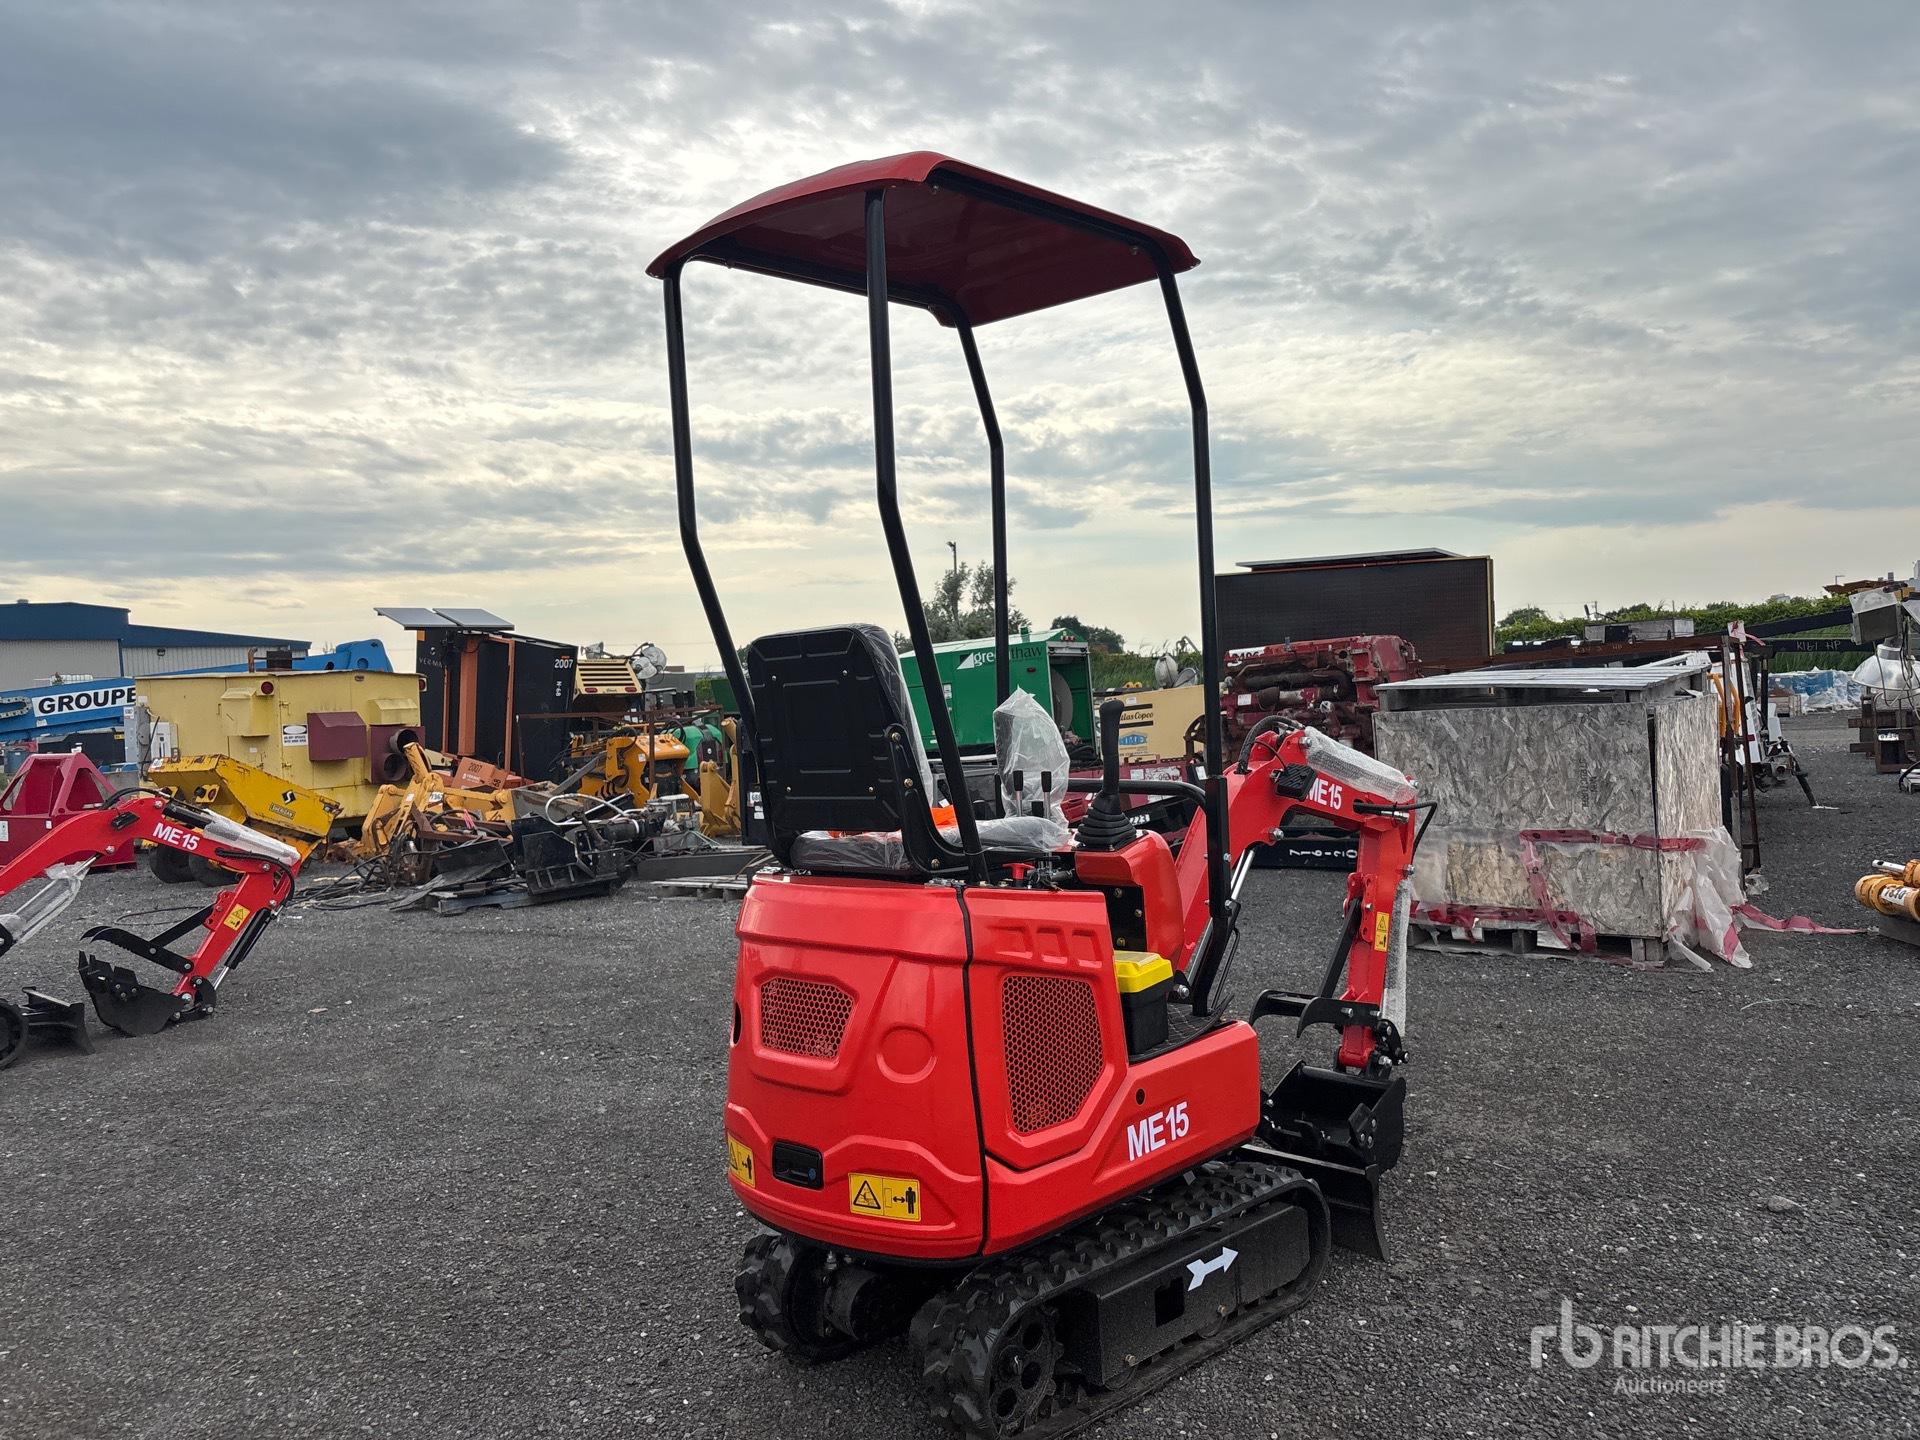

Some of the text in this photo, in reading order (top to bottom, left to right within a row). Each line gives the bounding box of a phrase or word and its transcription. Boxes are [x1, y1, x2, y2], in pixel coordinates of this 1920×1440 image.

[554, 658, 574, 669] 2007
[973, 646, 1042, 667] grethaw
[38, 687, 137, 715] GROUPE
[1134, 710, 1154, 721] Copco
[467, 762, 483, 773] 2007
[1305, 777, 1343, 810] ME15
[153, 822, 200, 851] ME15
[1127, 1101, 1190, 1162] ME15
